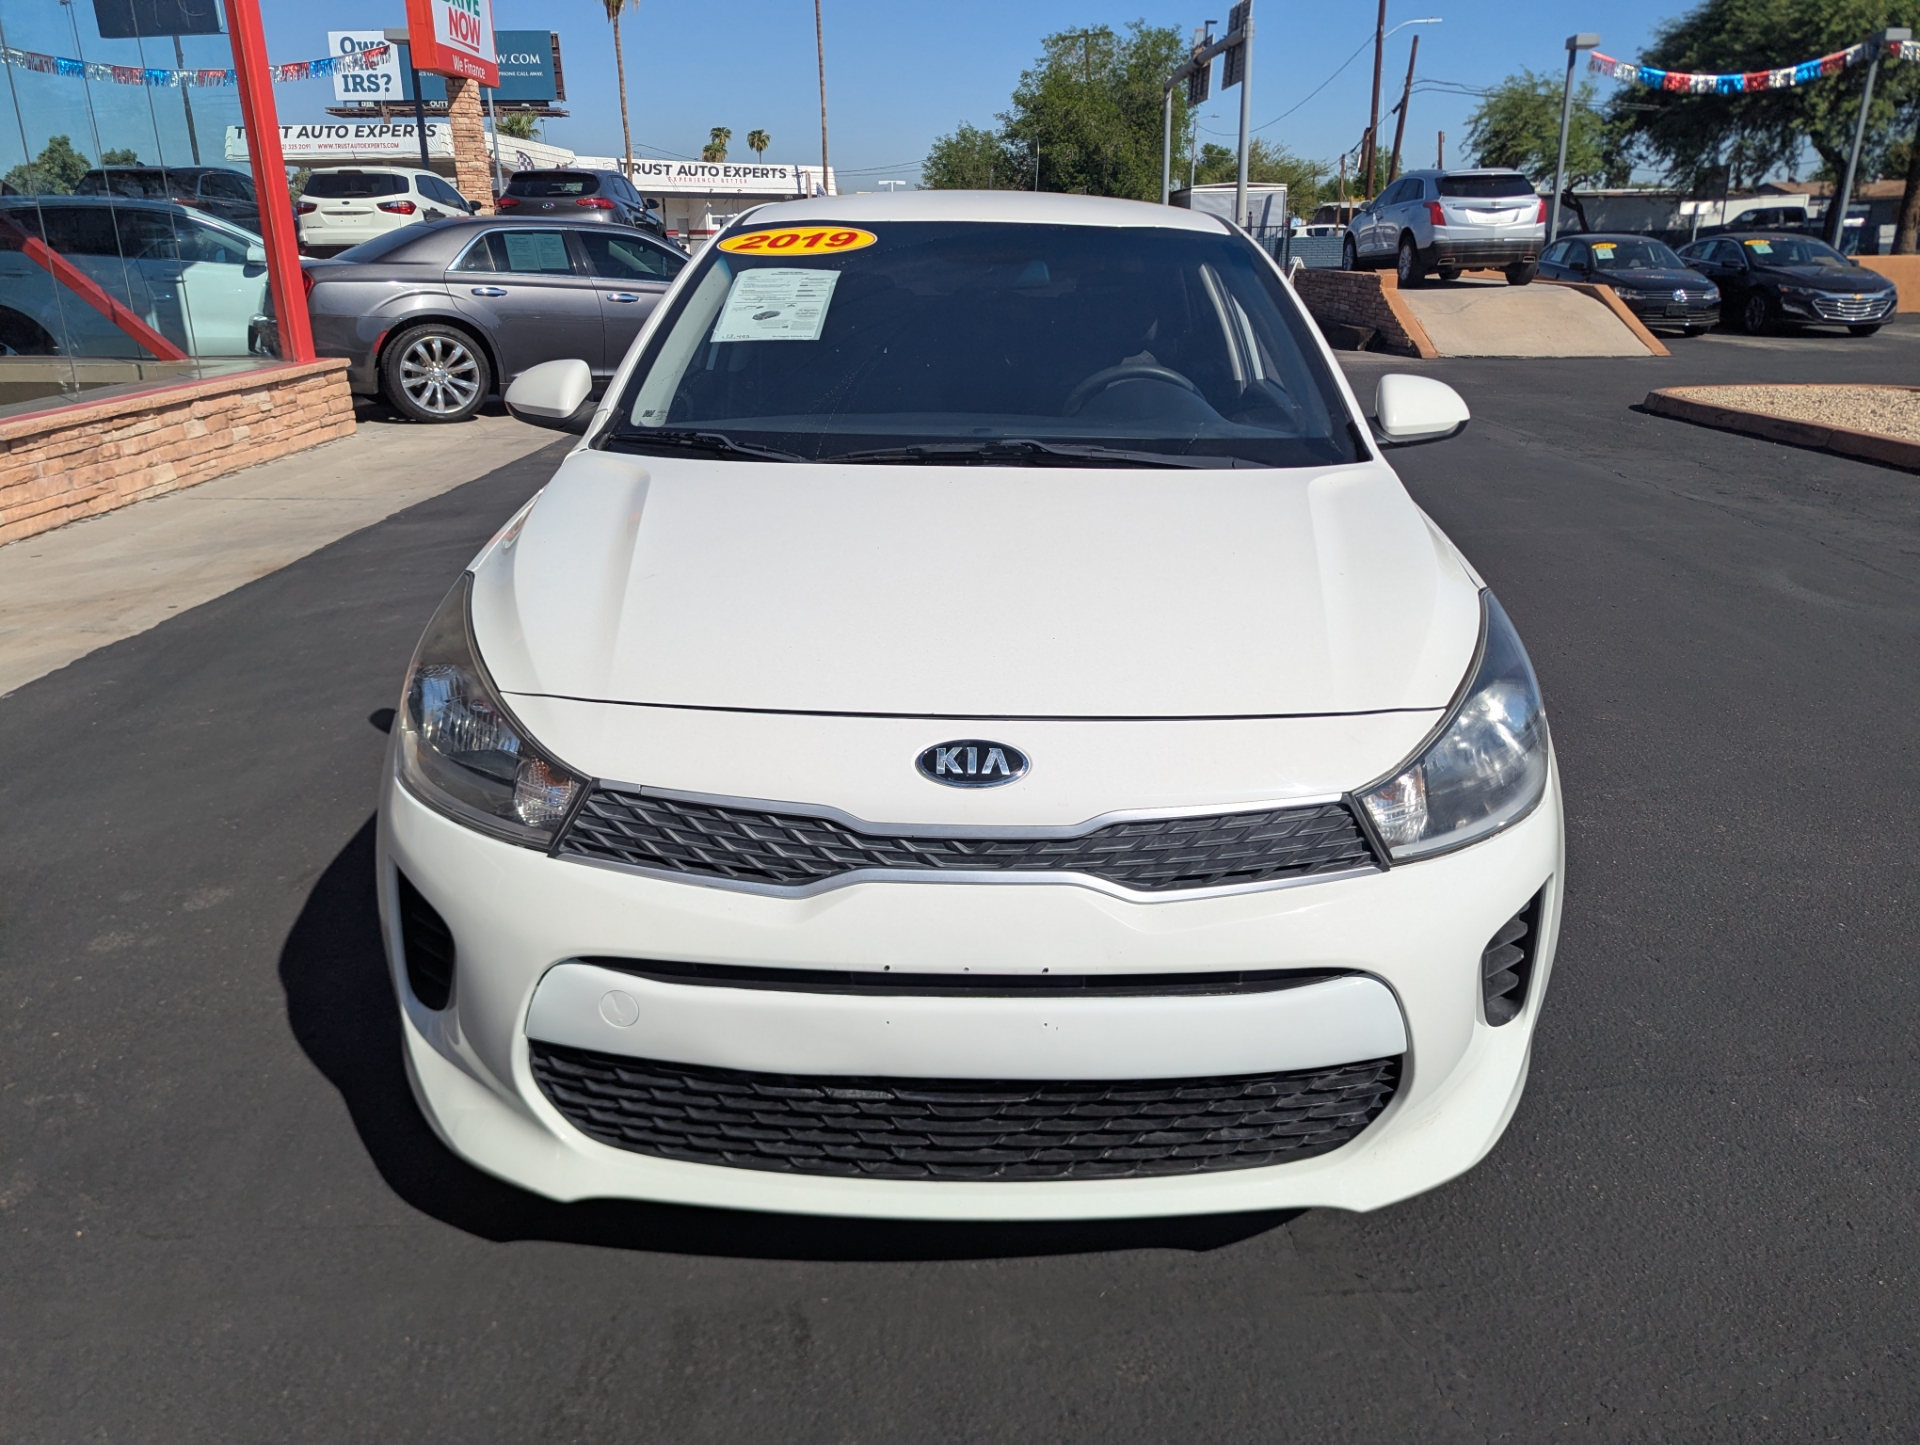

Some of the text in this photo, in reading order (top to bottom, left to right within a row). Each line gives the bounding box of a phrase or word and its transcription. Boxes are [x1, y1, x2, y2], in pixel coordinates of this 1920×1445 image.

[449, 6, 480, 46] NOW
[452, 54, 486, 79] We Finance
[342, 73, 392, 92] IRS?
[296, 125, 349, 139] AUTO
[354, 124, 438, 138] EXPERS
[621, 161, 787, 179] TRUST AUTO EXPERTS
[732, 231, 859, 250] 2019
[935, 746, 1011, 776] KIA
